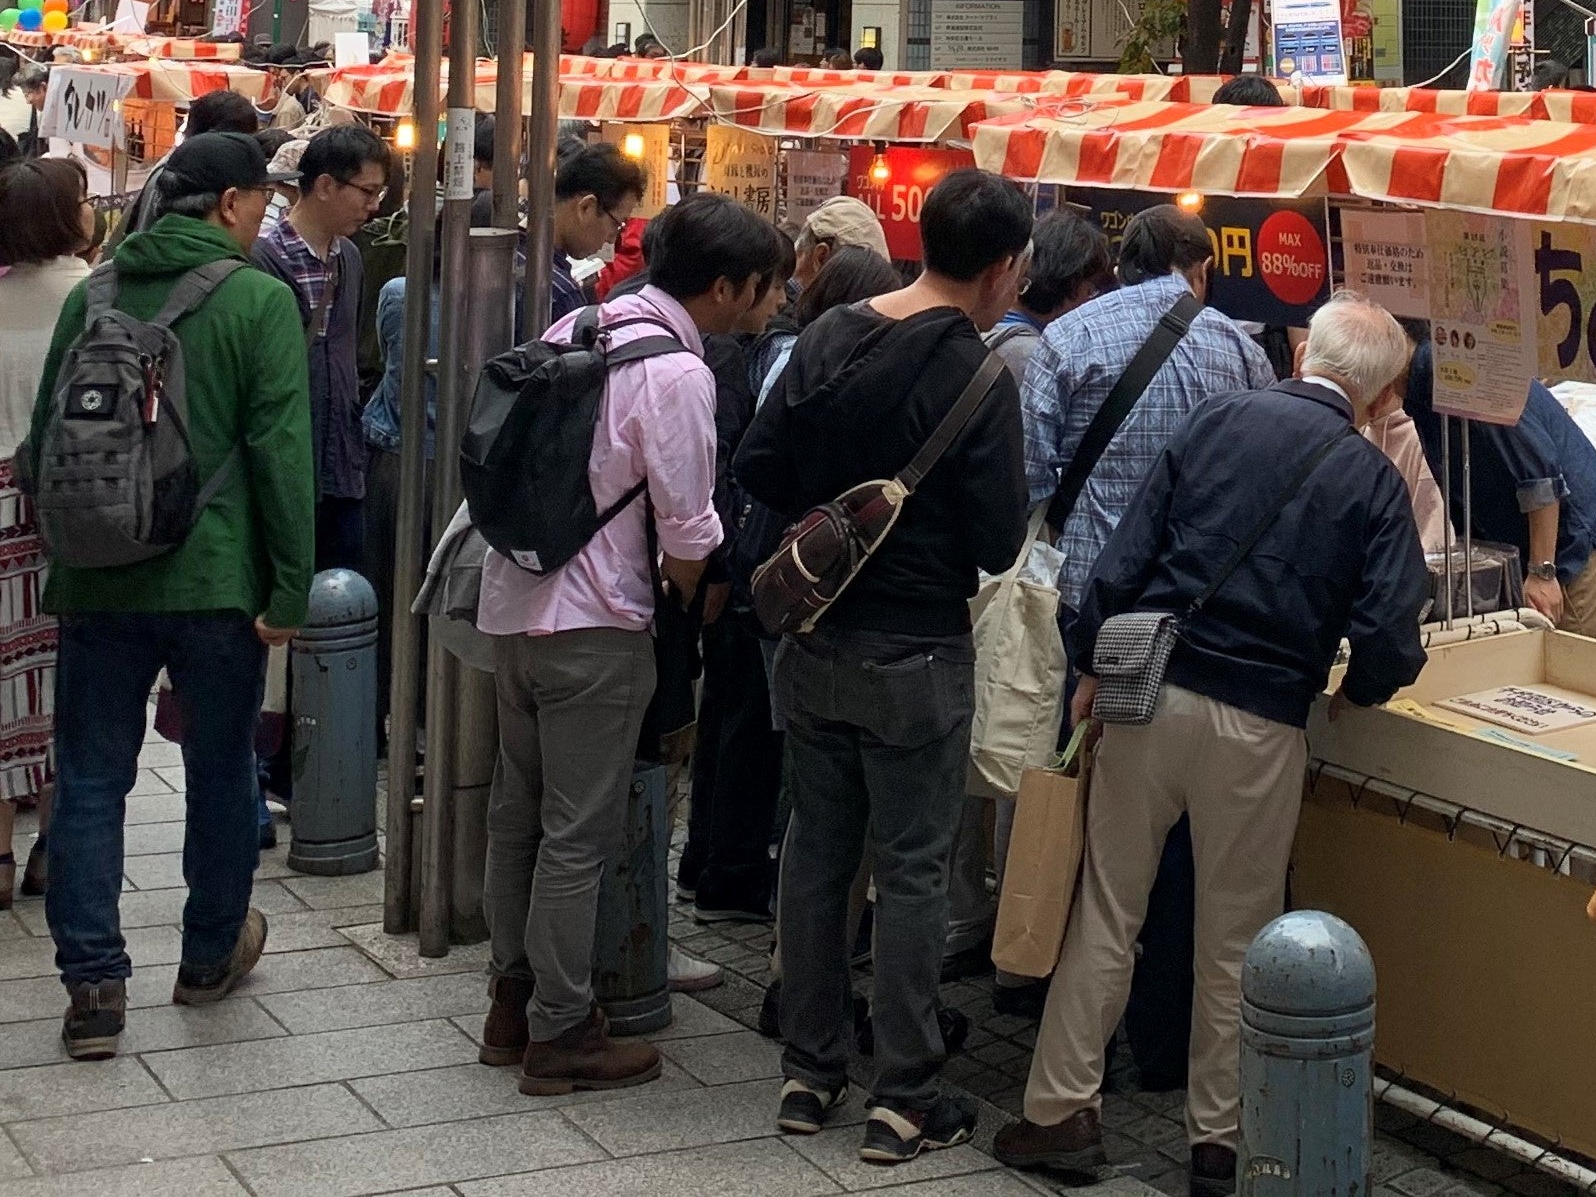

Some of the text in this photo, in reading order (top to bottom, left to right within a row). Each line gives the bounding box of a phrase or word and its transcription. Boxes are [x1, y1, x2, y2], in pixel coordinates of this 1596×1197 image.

[1278, 232, 1302, 247] MAX
[1354, 243, 1425, 259] 特別奉仕価格のため
[1261, 251, 1323, 279] 88%OFF
